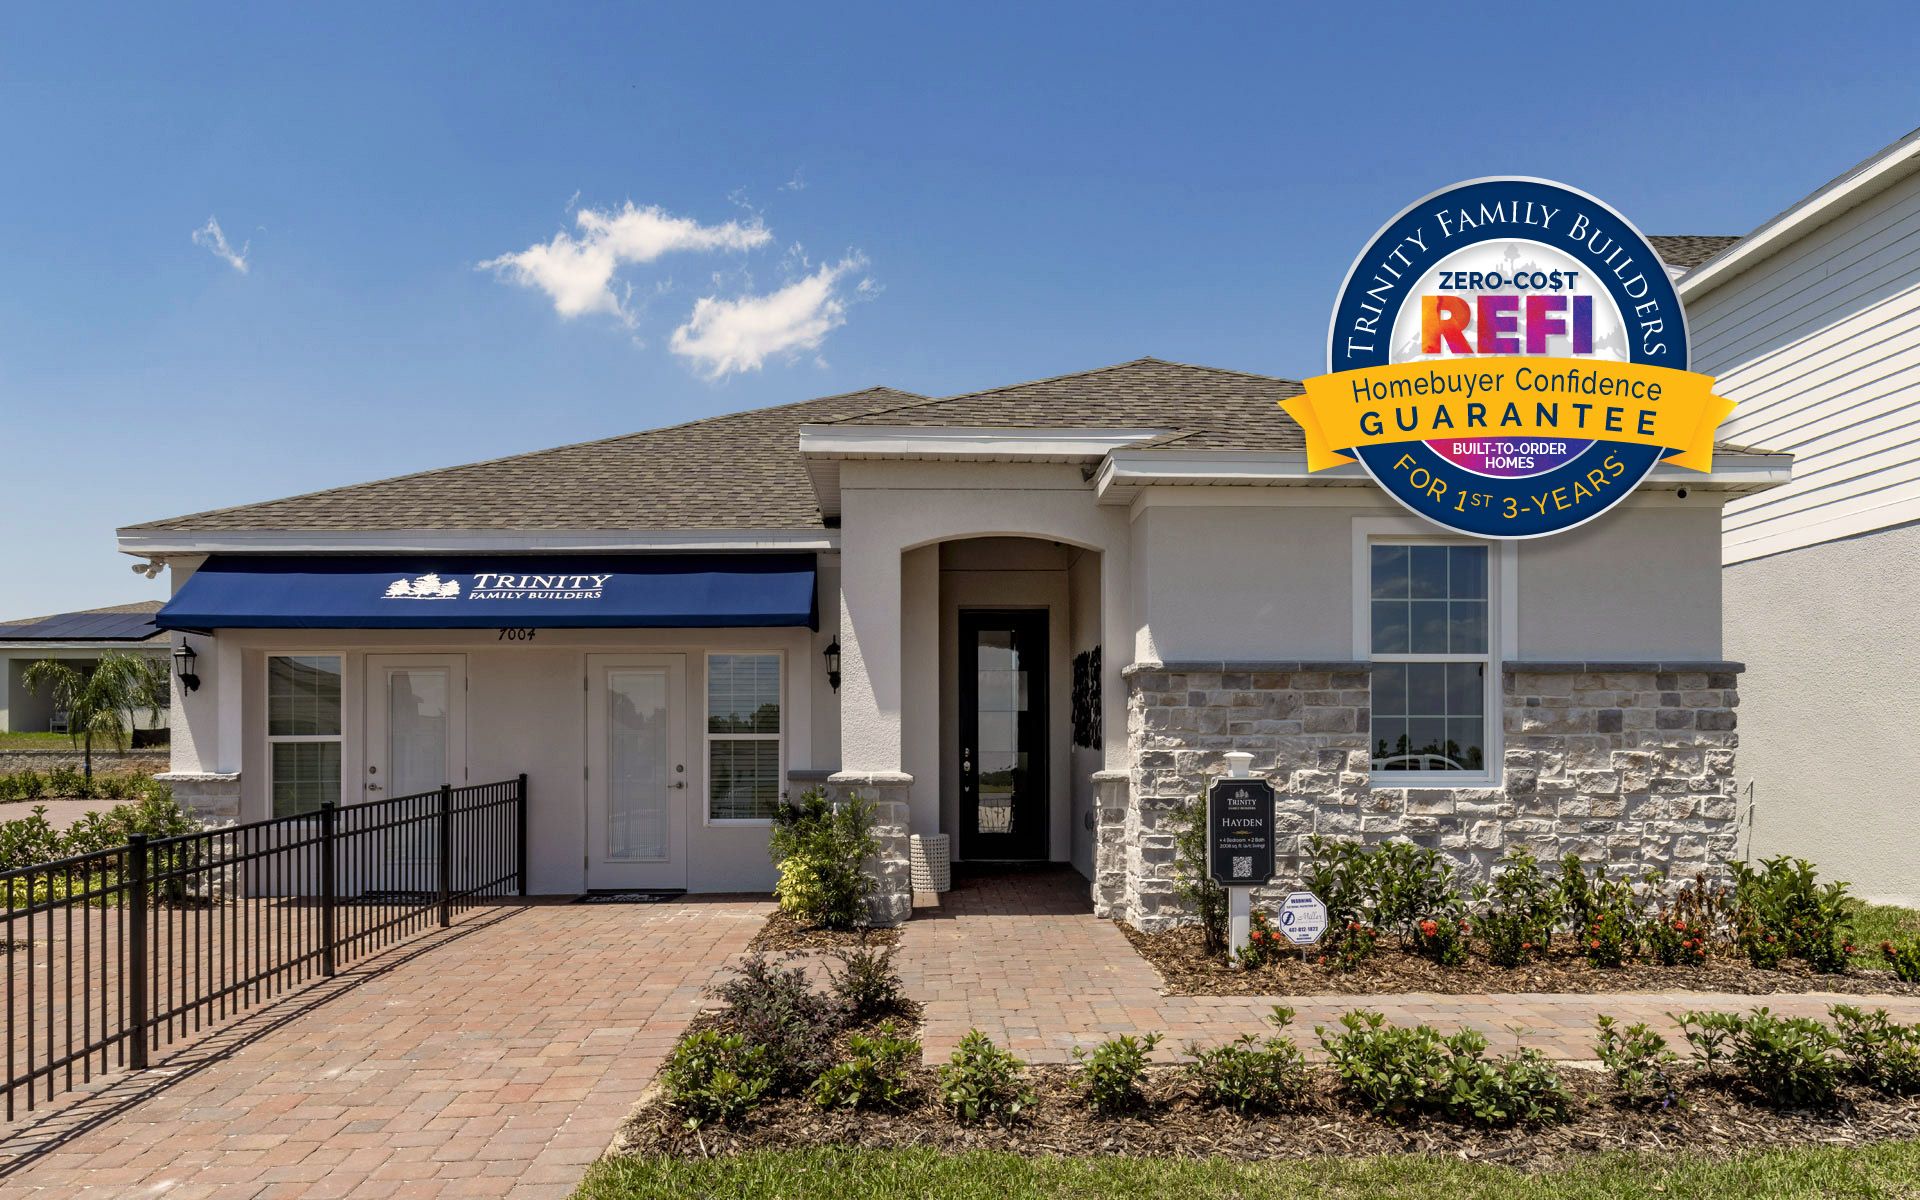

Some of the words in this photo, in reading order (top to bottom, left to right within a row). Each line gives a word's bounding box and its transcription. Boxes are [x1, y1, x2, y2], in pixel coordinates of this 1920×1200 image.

[473, 573, 613, 588] TRINITY
[469, 591, 524, 599] FAMILY
[528, 590, 602, 599] BUILDERS
[498, 627, 536, 641] 7004
[1227, 798, 1257, 806] TRINITY
[1222, 817, 1263, 828] HAYDEN
